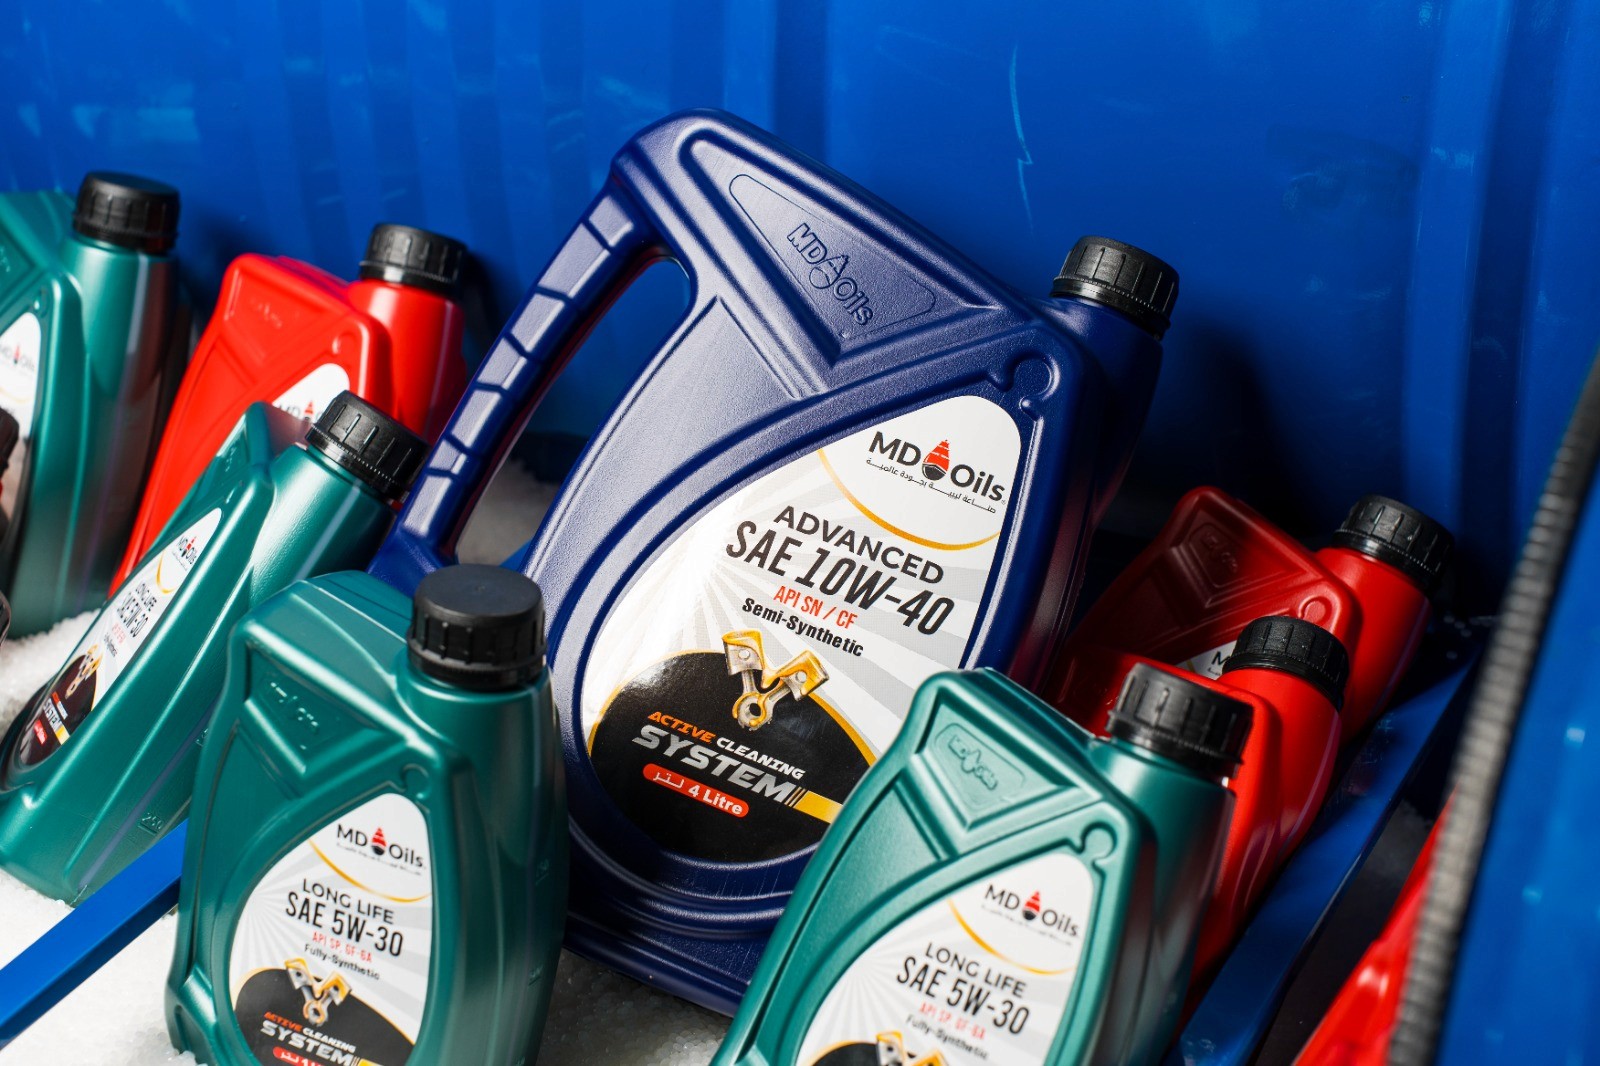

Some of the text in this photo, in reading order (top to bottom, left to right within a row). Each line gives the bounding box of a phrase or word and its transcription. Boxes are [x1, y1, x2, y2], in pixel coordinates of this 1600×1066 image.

[786, 222, 874, 326] MD Oils
[868, 431, 1006, 502] MD Oils
[773, 505, 945, 584] ADVANCED
[725, 520, 956, 636] SAE 10W-40
[742, 597, 864, 657] Semi-Synthetic
[773, 585, 858, 630] API SN / CF
[1211, 651, 1231, 665] M
[631, 724, 797, 803] SYSTEM
[648, 711, 806, 780] ACTIVE CLEANING
[688, 784, 701, 798] 4
[702, 788, 743, 815] Litre
[336, 823, 368, 847] MD
[389, 843, 423, 868] Oils
[286, 891, 403, 957] SAE 5W-30
[303, 878, 394, 925] LONG LIFE
[984, 884, 1020, 910] MD
[1042, 909, 1078, 936] Oils
[896, 956, 1030, 1034] SAE 5W-30
[925, 942, 1027, 998] LONG LIFE
[260, 1019, 354, 1066] SYSTEM
[302, 1027, 356, 1054] CLEANING
